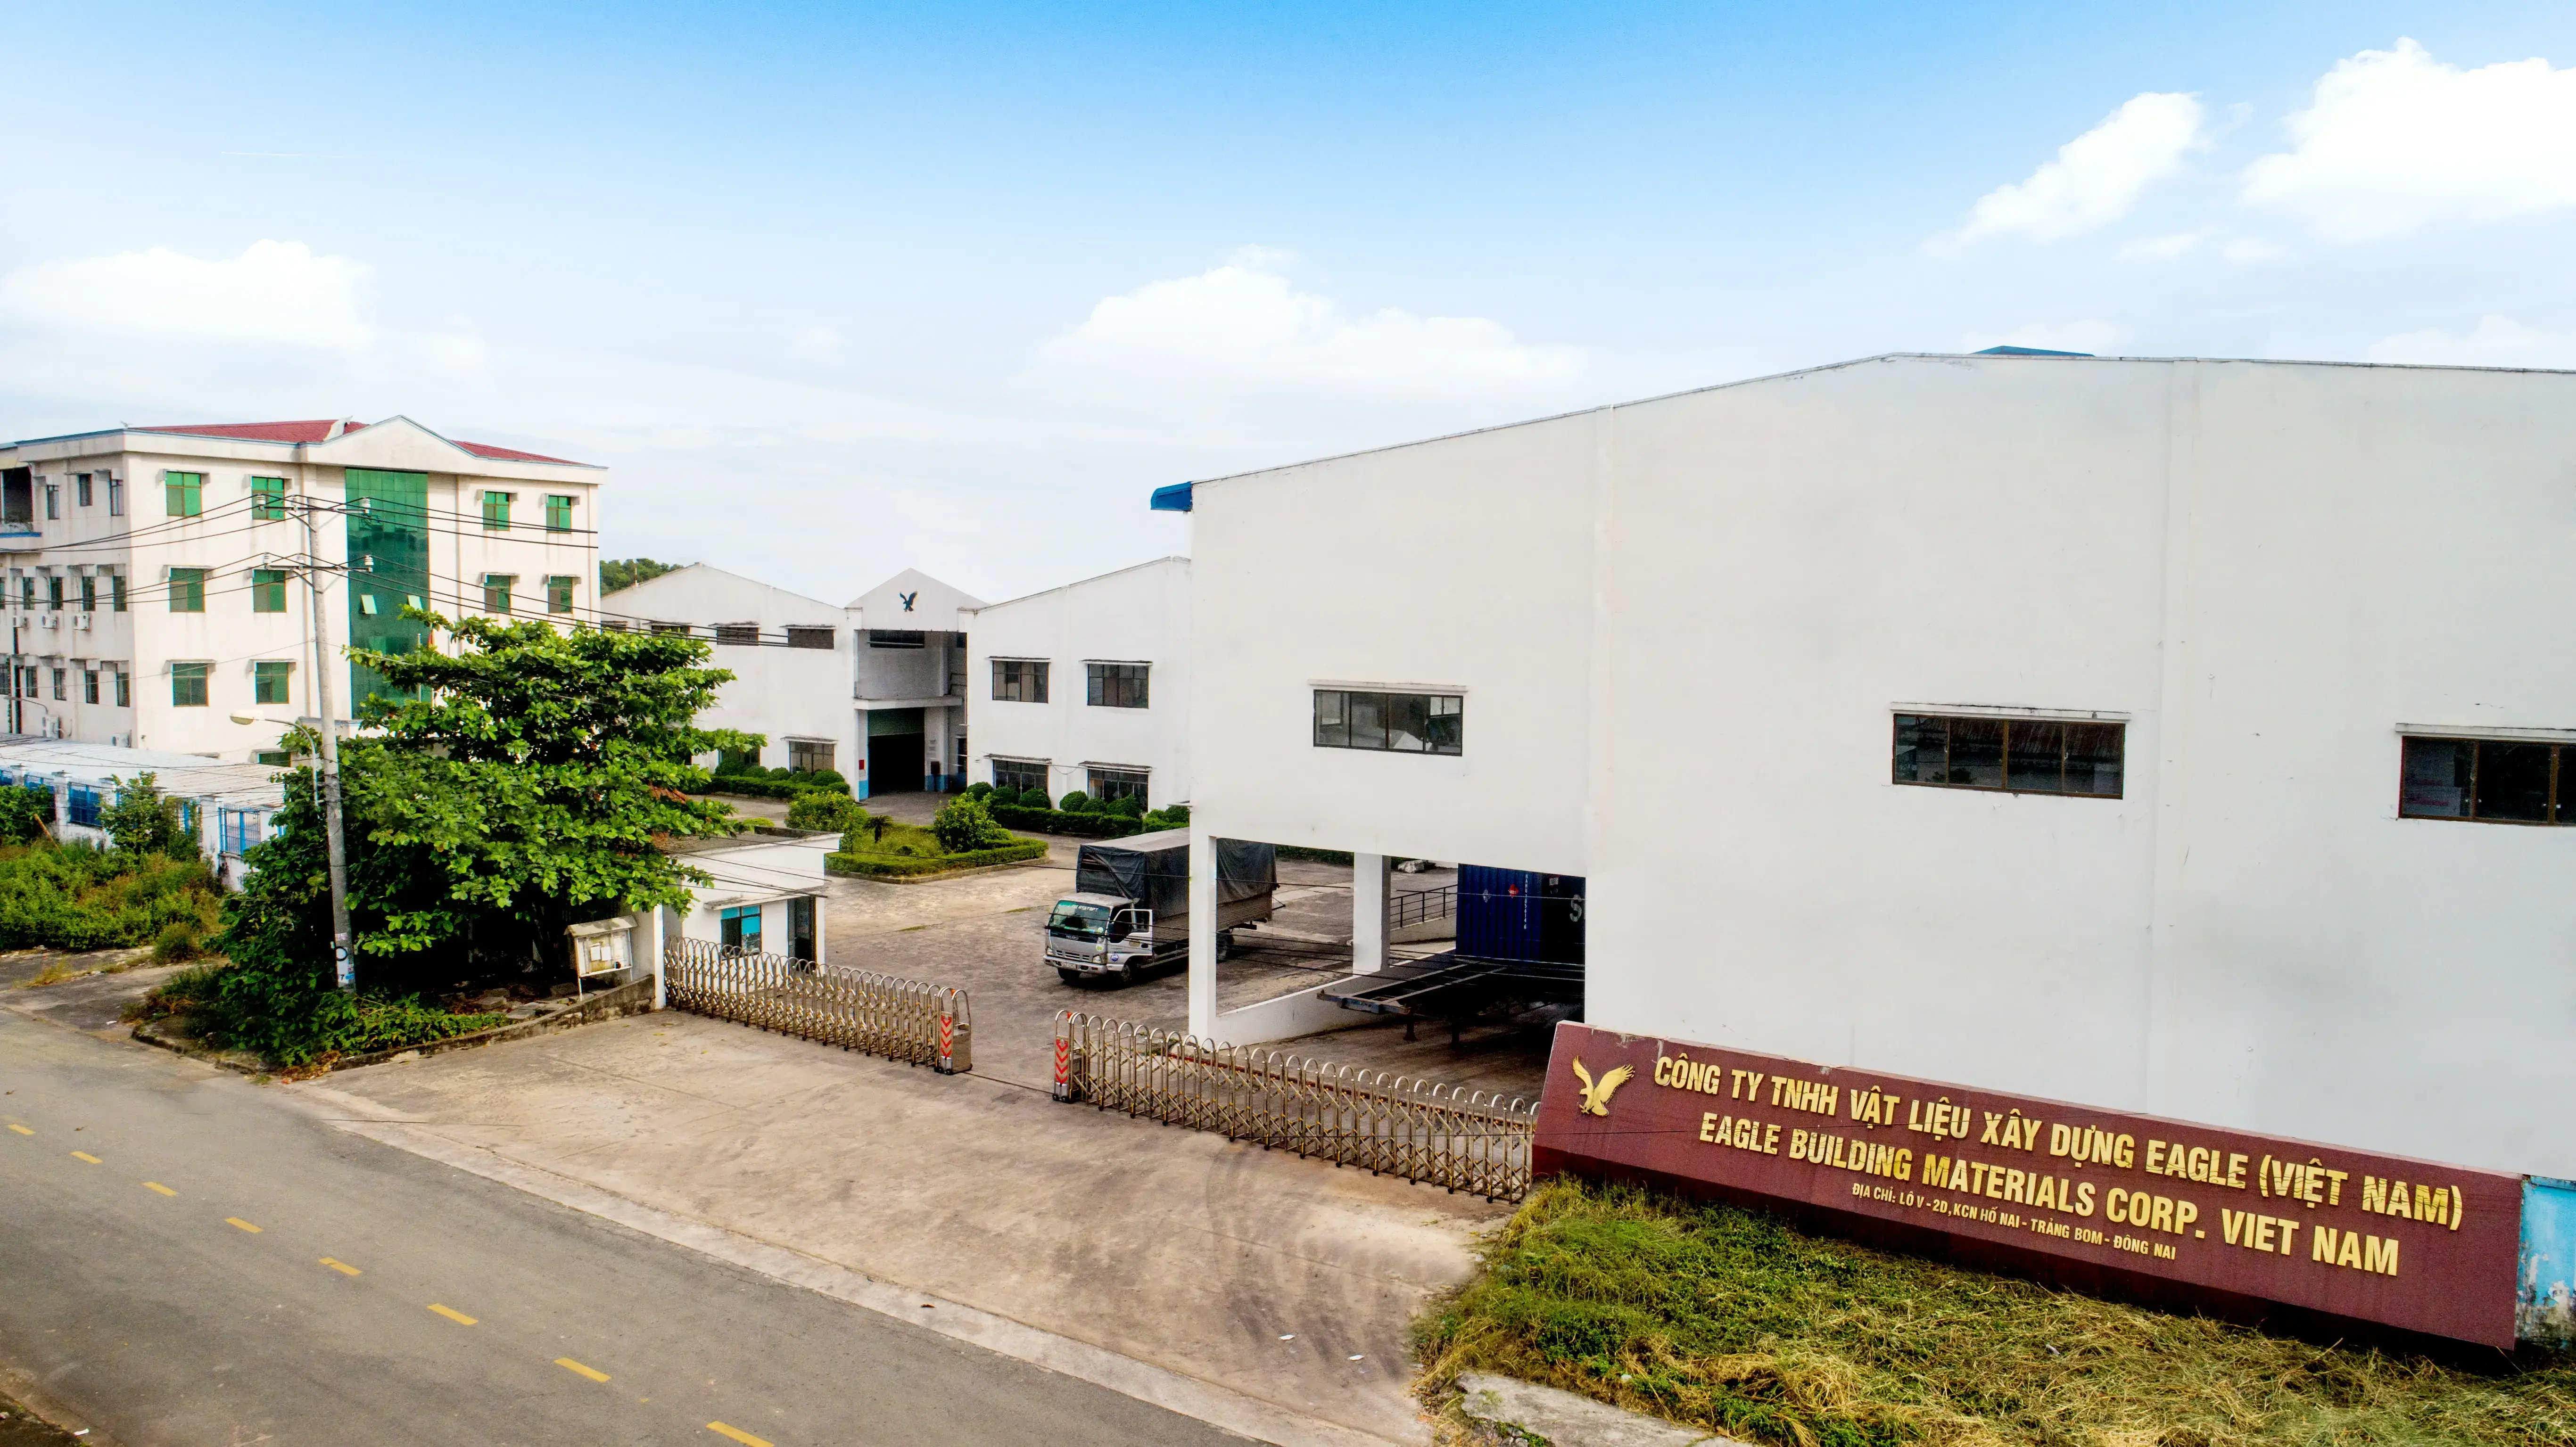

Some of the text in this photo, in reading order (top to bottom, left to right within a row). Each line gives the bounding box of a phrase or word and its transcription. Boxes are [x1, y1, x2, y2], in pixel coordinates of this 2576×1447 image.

[1655, 1052, 2462, 1231] CÔNG TY TNHH VẬT LIỆU XÂY DỰNG EAGLE (VIỆT NAM)
[1699, 1112, 2399, 1276] EAGLE BUILDING MATERIALS CORP. VIET NAM
[1852, 1183, 1870, 1199] ĐỊA
[1874, 1186, 1896, 1203] CHỈ:
[1899, 1191, 1914, 1207] LÔ
[1953, 1203, 1978, 1220] KCN
[1980, 1206, 1998, 1224] HỐ
[1999, 1212, 2020, 1228] NAI
[2031, 1217, 2070, 1239] TRẢNG
[2074, 1227, 2103, 1245] BOM
[2113, 1234, 2149, 1255] ĐÔNG
[2154, 1243, 2176, 1260] NAI
